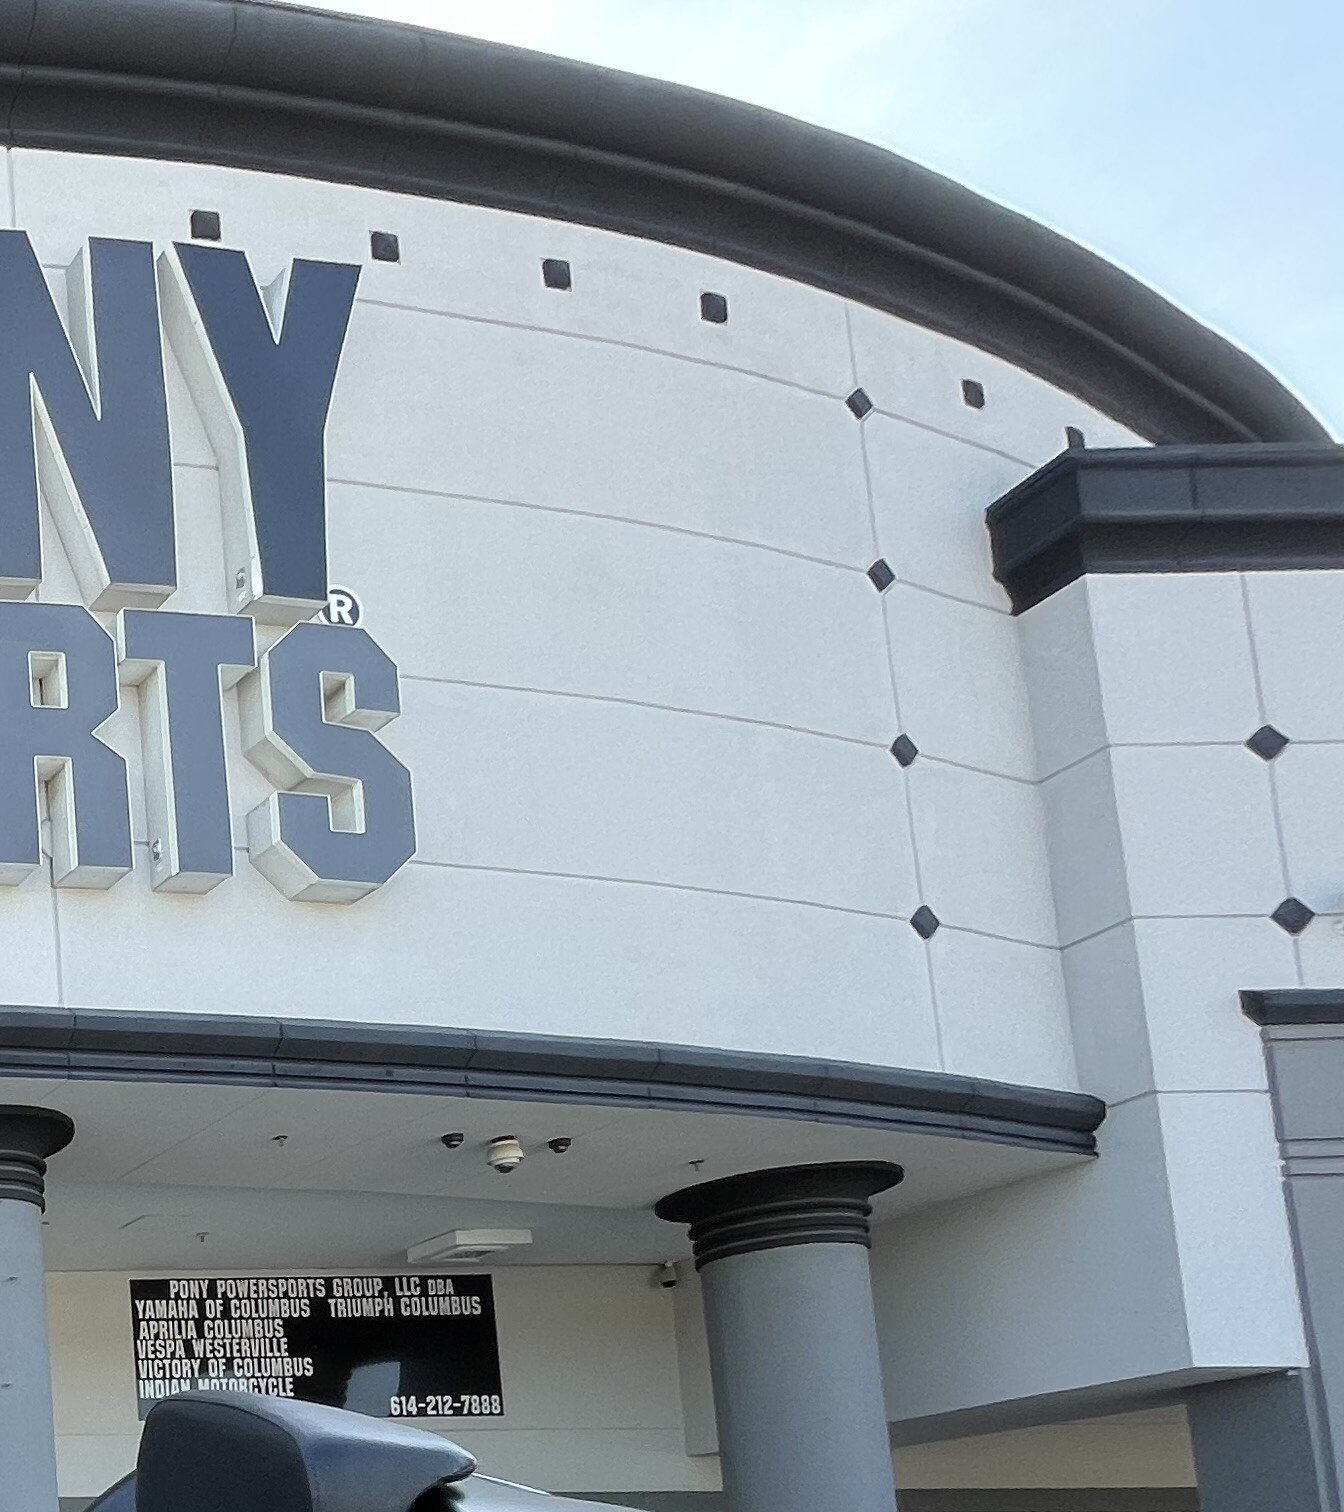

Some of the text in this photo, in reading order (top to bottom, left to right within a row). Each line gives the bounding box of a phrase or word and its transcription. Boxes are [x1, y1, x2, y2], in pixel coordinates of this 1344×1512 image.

[169, 1276, 454, 1299] PONY POWERSPORTS GROUP, LLC DBA
[135, 1298, 311, 1319] YAMAHA OF COLUMBUS
[328, 1296, 482, 1318] TRIUMPH COLUMBUS
[139, 1319, 284, 1340] APRILIA COLUMBUS
[136, 1337, 289, 1359] VESPA WESTERVILLE
[138, 1357, 314, 1379] VICTORY OF COLUMBUS
[138, 1377, 295, 1399] INDIAN MOTORCYCLE
[390, 1395, 502, 1416] 614-212-7888
